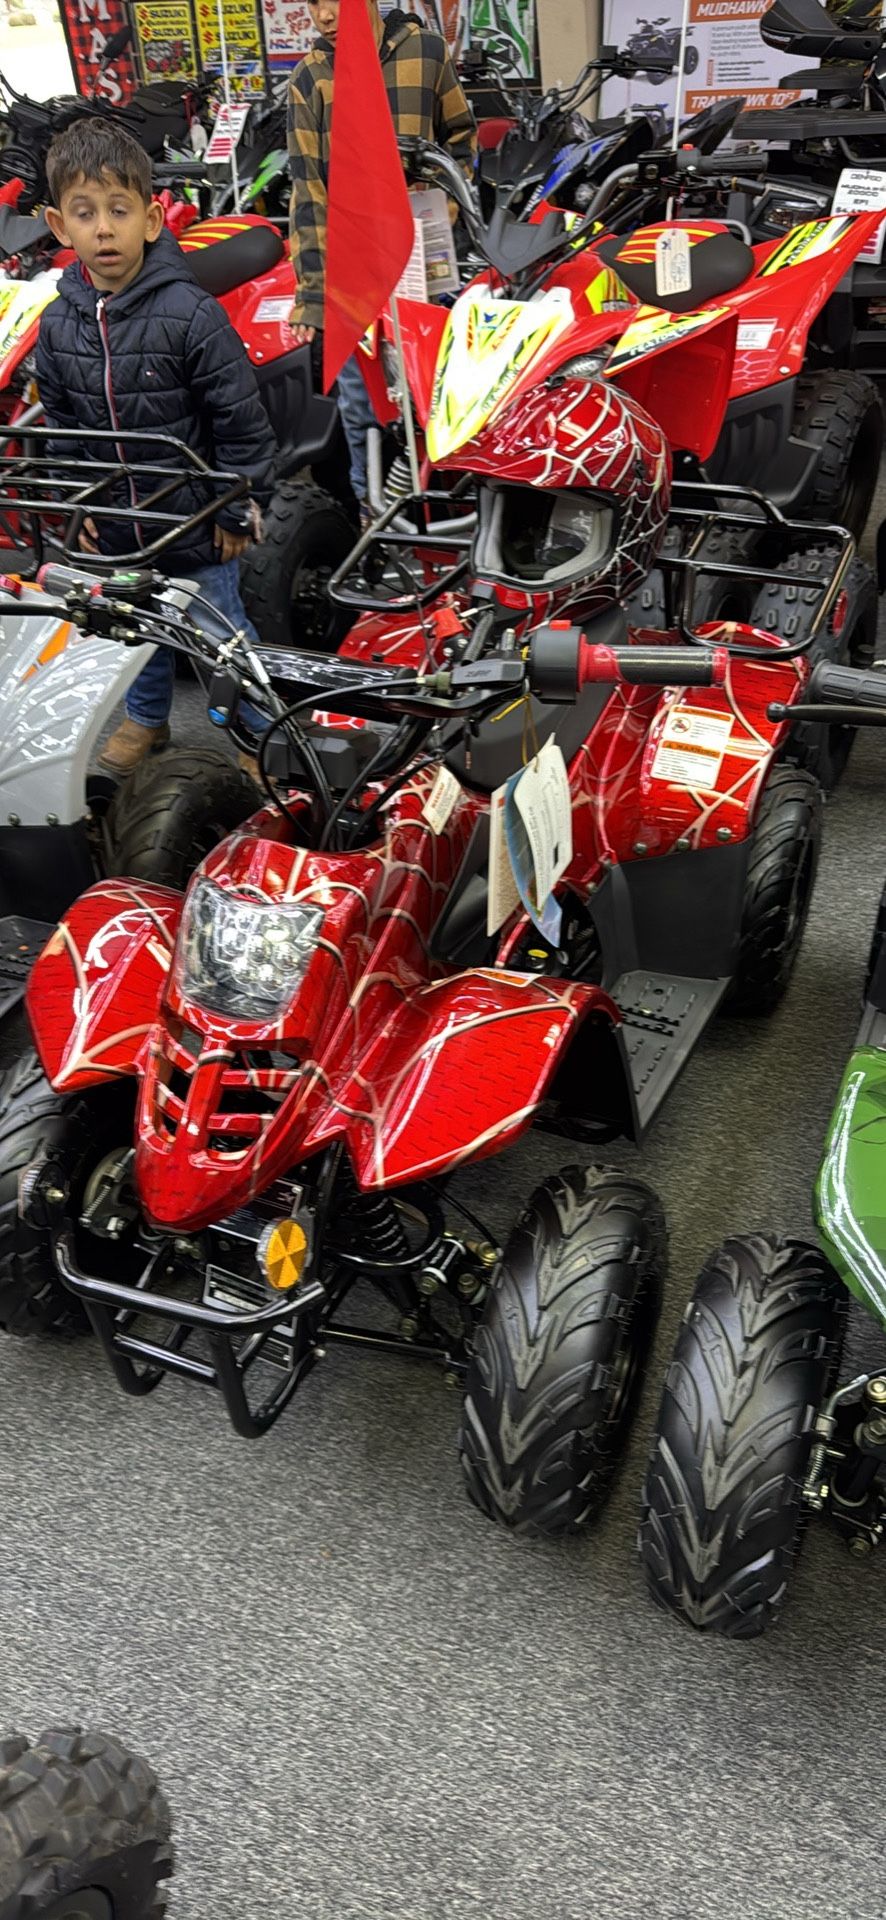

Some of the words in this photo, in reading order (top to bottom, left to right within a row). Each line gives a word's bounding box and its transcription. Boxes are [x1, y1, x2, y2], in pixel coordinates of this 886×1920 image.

[212, 4, 253, 14] SUZUKI
[696, 0, 769, 16] MUDHAWK
[150, 9, 187, 18] SUZUKI
[153, 27, 189, 37] SUZUKI
[215, 30, 256, 41] SUZUKI
